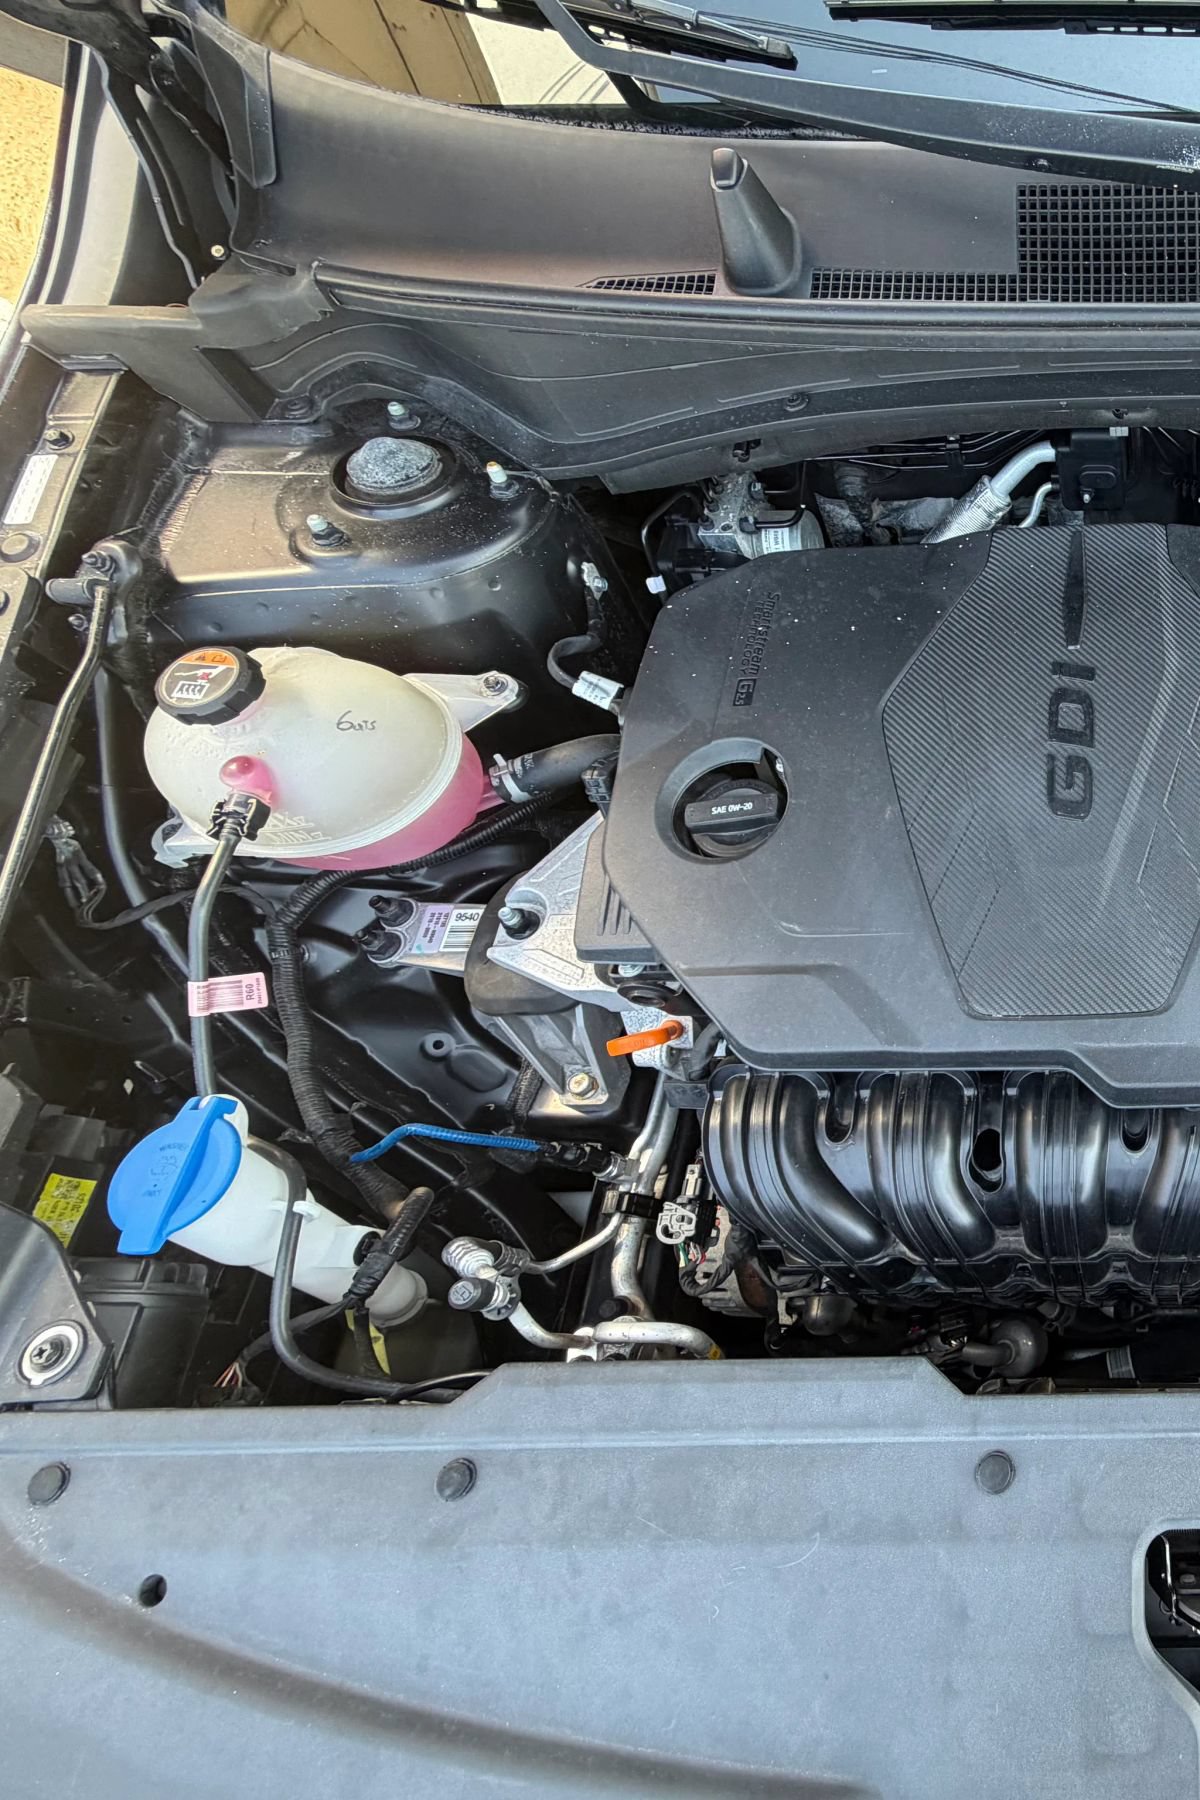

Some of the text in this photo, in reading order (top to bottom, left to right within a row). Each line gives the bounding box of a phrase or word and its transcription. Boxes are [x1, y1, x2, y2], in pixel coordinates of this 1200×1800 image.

[1047, 661, 1096, 821] GDI
[711, 801, 753, 815] SAE 0W-20
[455, 912, 480, 922] 9540
